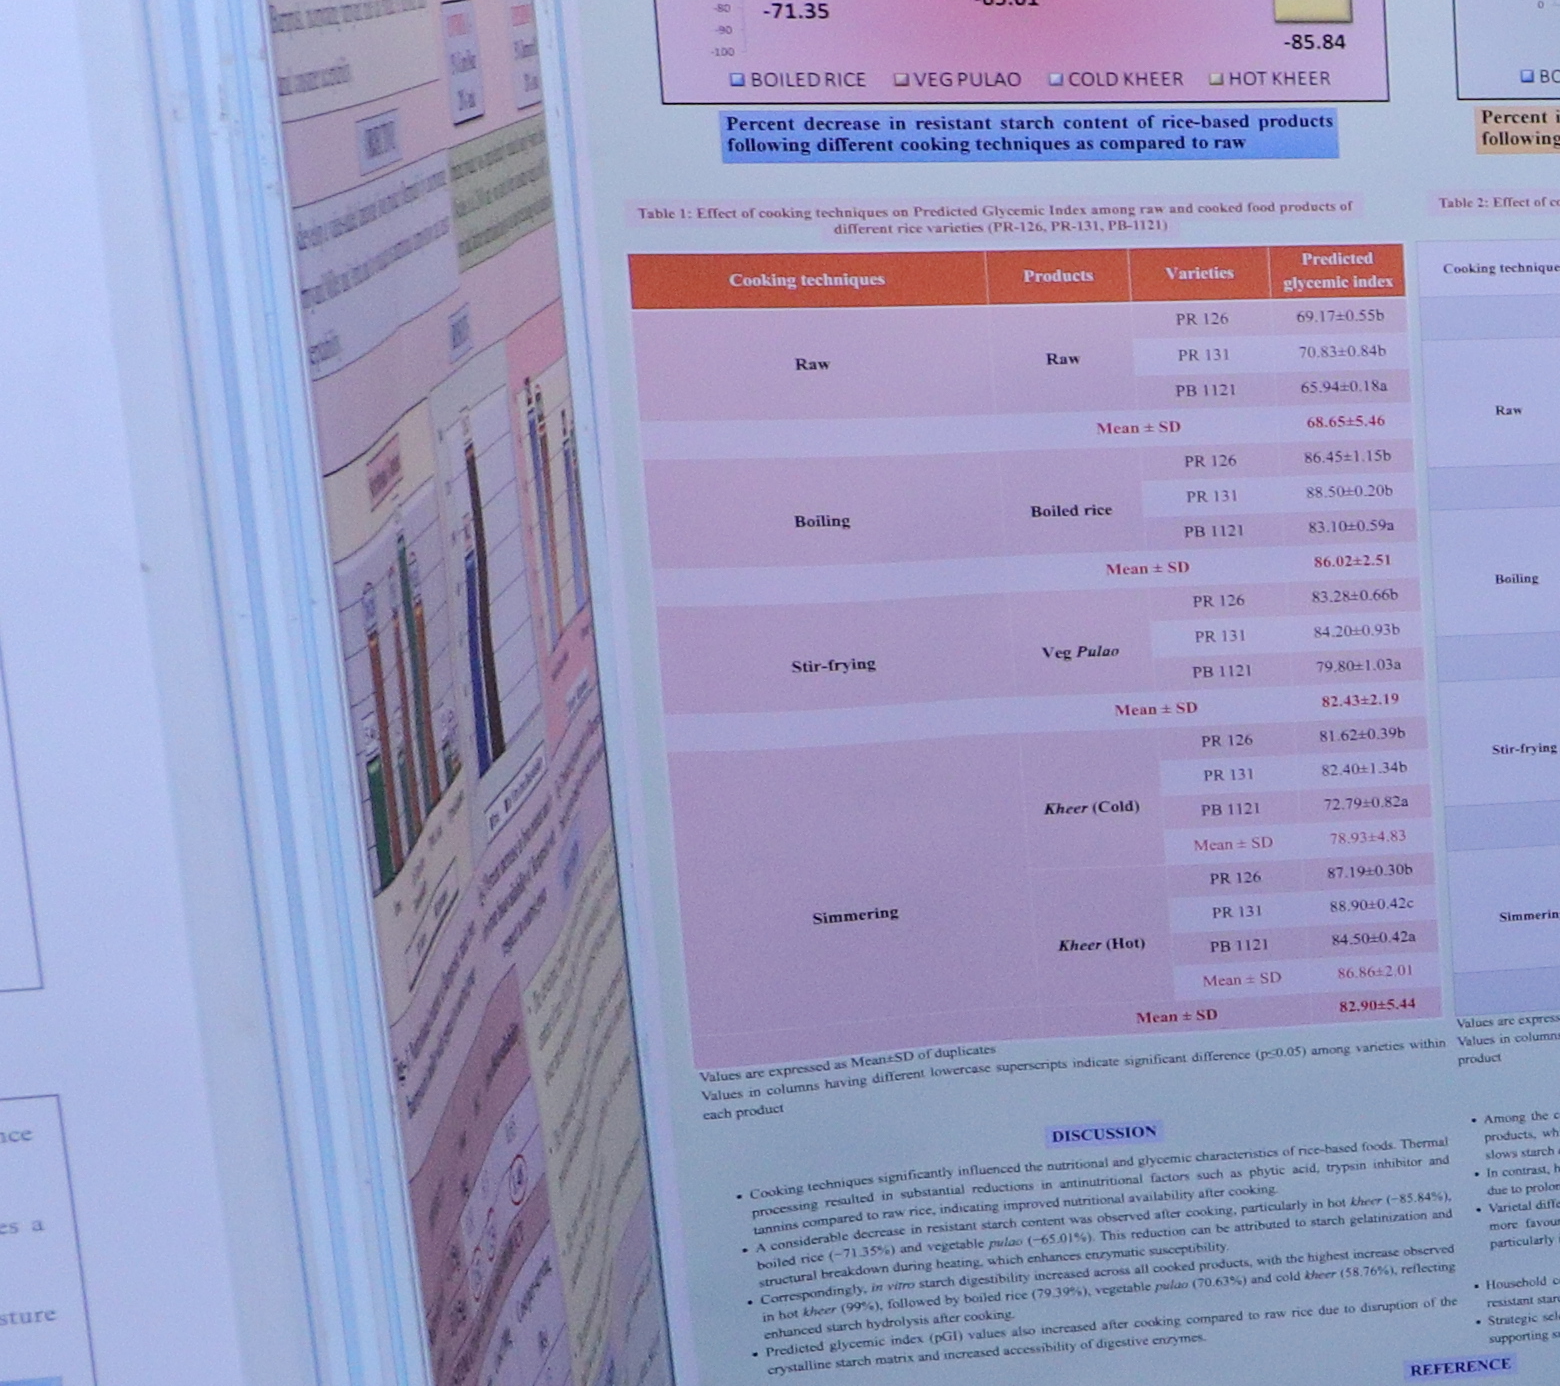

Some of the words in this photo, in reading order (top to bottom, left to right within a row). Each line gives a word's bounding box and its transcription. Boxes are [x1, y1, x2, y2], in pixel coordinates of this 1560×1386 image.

[763, 2, 830, 20] -71.35
[1284, 33, 1346, 50] -85.84
[726, 116, 795, 132] Percent
[803, 116, 881, 131] decrease
[889, 116, 906, 131] in
[915, 116, 992, 131] resistant
[1000, 115, 1055, 130] starch
[1063, 117, 1129, 130] content
[1136, 114, 1155, 129] of
[1162, 113, 1250, 129] rice-based
[1258, 113, 1333, 132] products
[1302, 251, 1374, 266] Predicted
[728, 273, 797, 290] Cooking
[800, 272, 886, 290] techniques
[1023, 269, 1094, 283] Products
[1165, 266, 1235, 280] Varieties
[1283, 275, 1349, 293] glycemic
[1353, 274, 1394, 288] index
[1043, 802, 1089, 816] Kheer
[1092, 799, 1140, 815] (Cold)
[1052, 1125, 1156, 1143] DISCUSSION
[1410, 1357, 1512, 1377] REFERENCE
